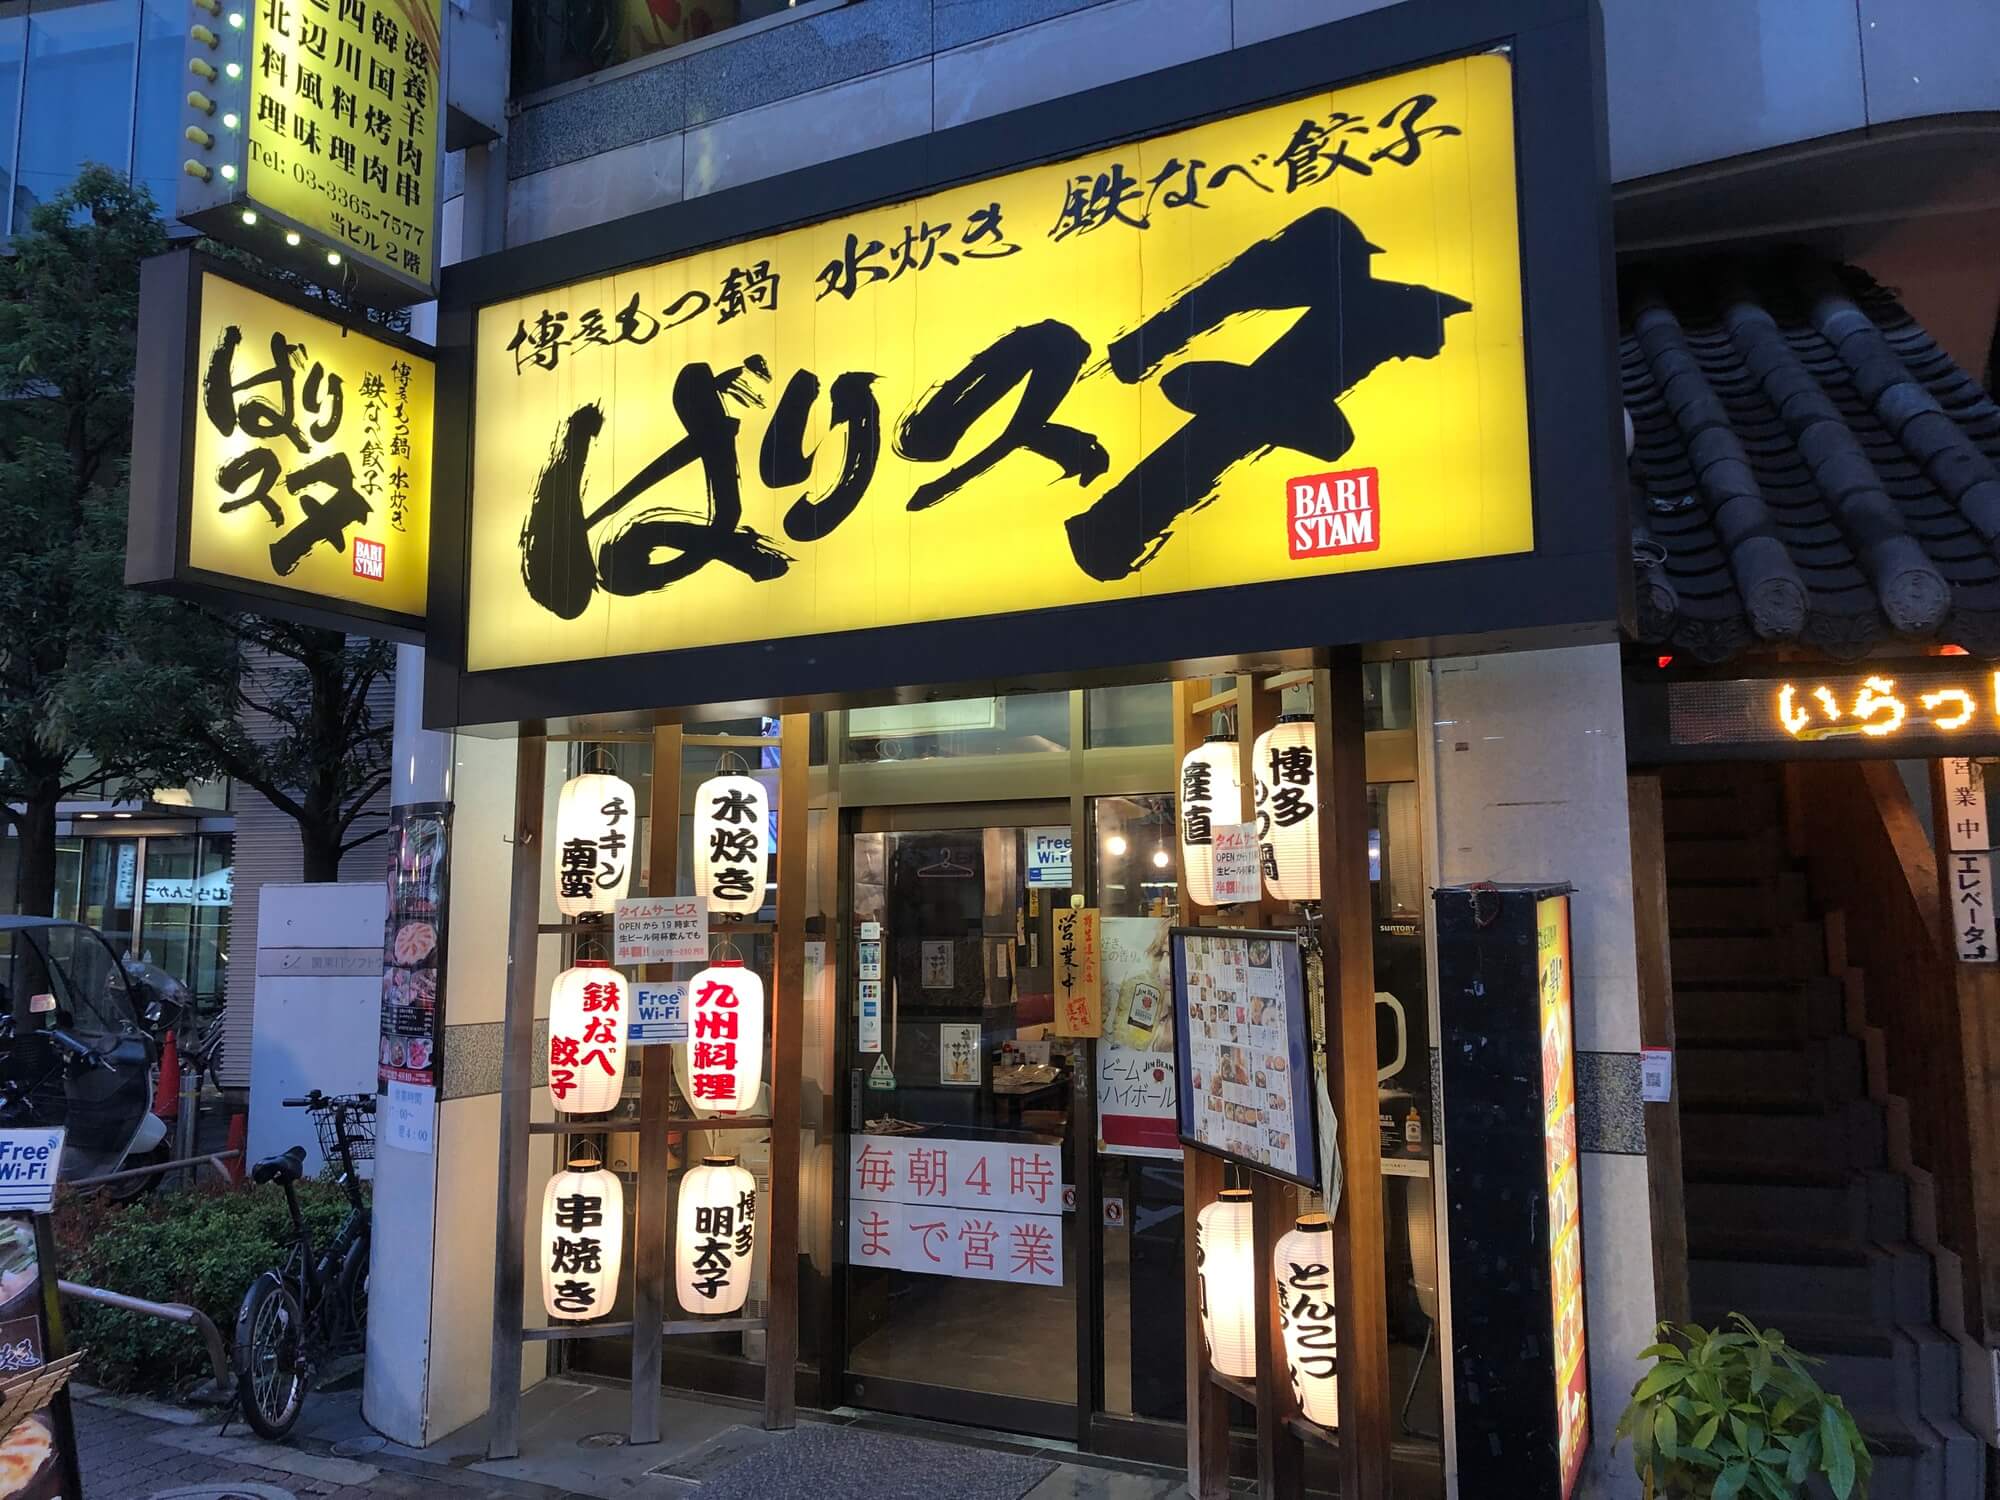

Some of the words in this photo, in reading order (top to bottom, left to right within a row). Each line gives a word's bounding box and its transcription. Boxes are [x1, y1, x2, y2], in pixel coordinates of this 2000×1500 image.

[329, 0, 364, 176] 四川料理
[293, 162, 425, 246] 03-3365-7577
[506, 260, 781, 376] 博多もつ鍋
[816, 202, 1021, 301] 水炊き
[1047, 94, 1461, 241] 鉄なべ餃子
[389, 467, 408, 533] 水炊き
[1294, 474, 1370, 517] BARI
[355, 541, 383, 563] BARI
[1295, 510, 1373, 552] STAM
[354, 557, 382, 578] STAM
[1183, 761, 1212, 845] 産直
[1269, 746, 1315, 828] 博多
[561, 838, 598, 899] 南蛮
[596, 797, 629, 890] チキン
[710, 789, 758, 901] 水炊き
[1037, 836, 1072, 849] Free
[618, 903, 697, 917] タイムサービス
[619, 922, 641, 931] OPEN
[643, 921, 658, 930] から
[661, 920, 672, 929] 19
[1058, 910, 1079, 999] 営業中
[638, 991, 680, 1005] Free
[638, 1006, 680, 1020] Wi-Fi
[550, 1034, 580, 1099] 餃子
[693, 980, 739, 1100] 九州料理
[1102, 1059, 1140, 1081] ビーム
[1102, 1085, 1178, 1108] ハイボール
[0, 1141, 49, 1163] Free
[0, 1162, 47, 1182] Wi-Fi
[856, 1144, 1054, 1203] 毎朝4時
[551, 1193, 602, 1313] 串焼き
[692, 1206, 735, 1300] 明太子
[734, 1190, 756, 1258] 博多
[858, 1211, 1055, 1275] まで営業
[1289, 1262, 1337, 1379] とんこつ
